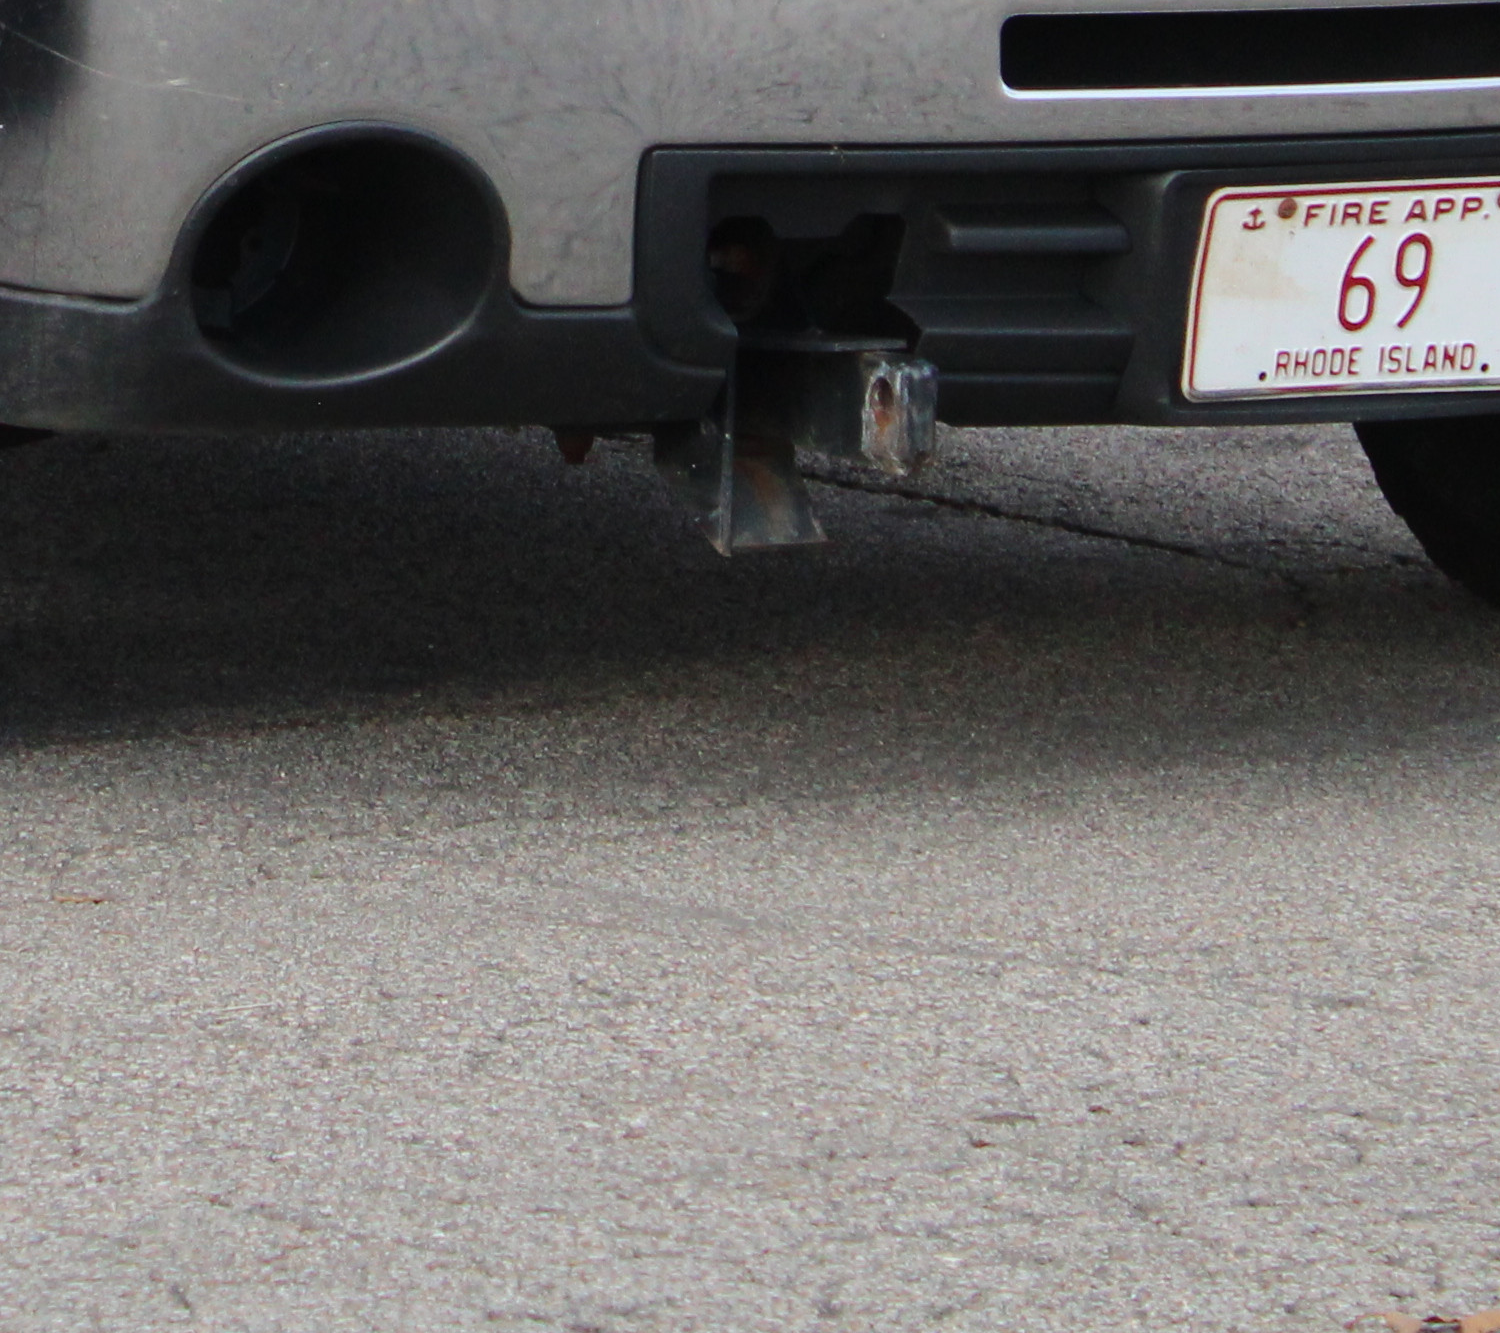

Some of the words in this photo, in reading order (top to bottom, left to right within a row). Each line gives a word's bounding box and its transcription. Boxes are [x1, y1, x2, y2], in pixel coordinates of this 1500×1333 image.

[1302, 200, 1391, 229] FIRE
[1404, 196, 1491, 223] APP.
[1336, 232, 1434, 333] 69
[1273, 345, 1361, 378] RHODE
[1377, 341, 1477, 374] ISLAND
